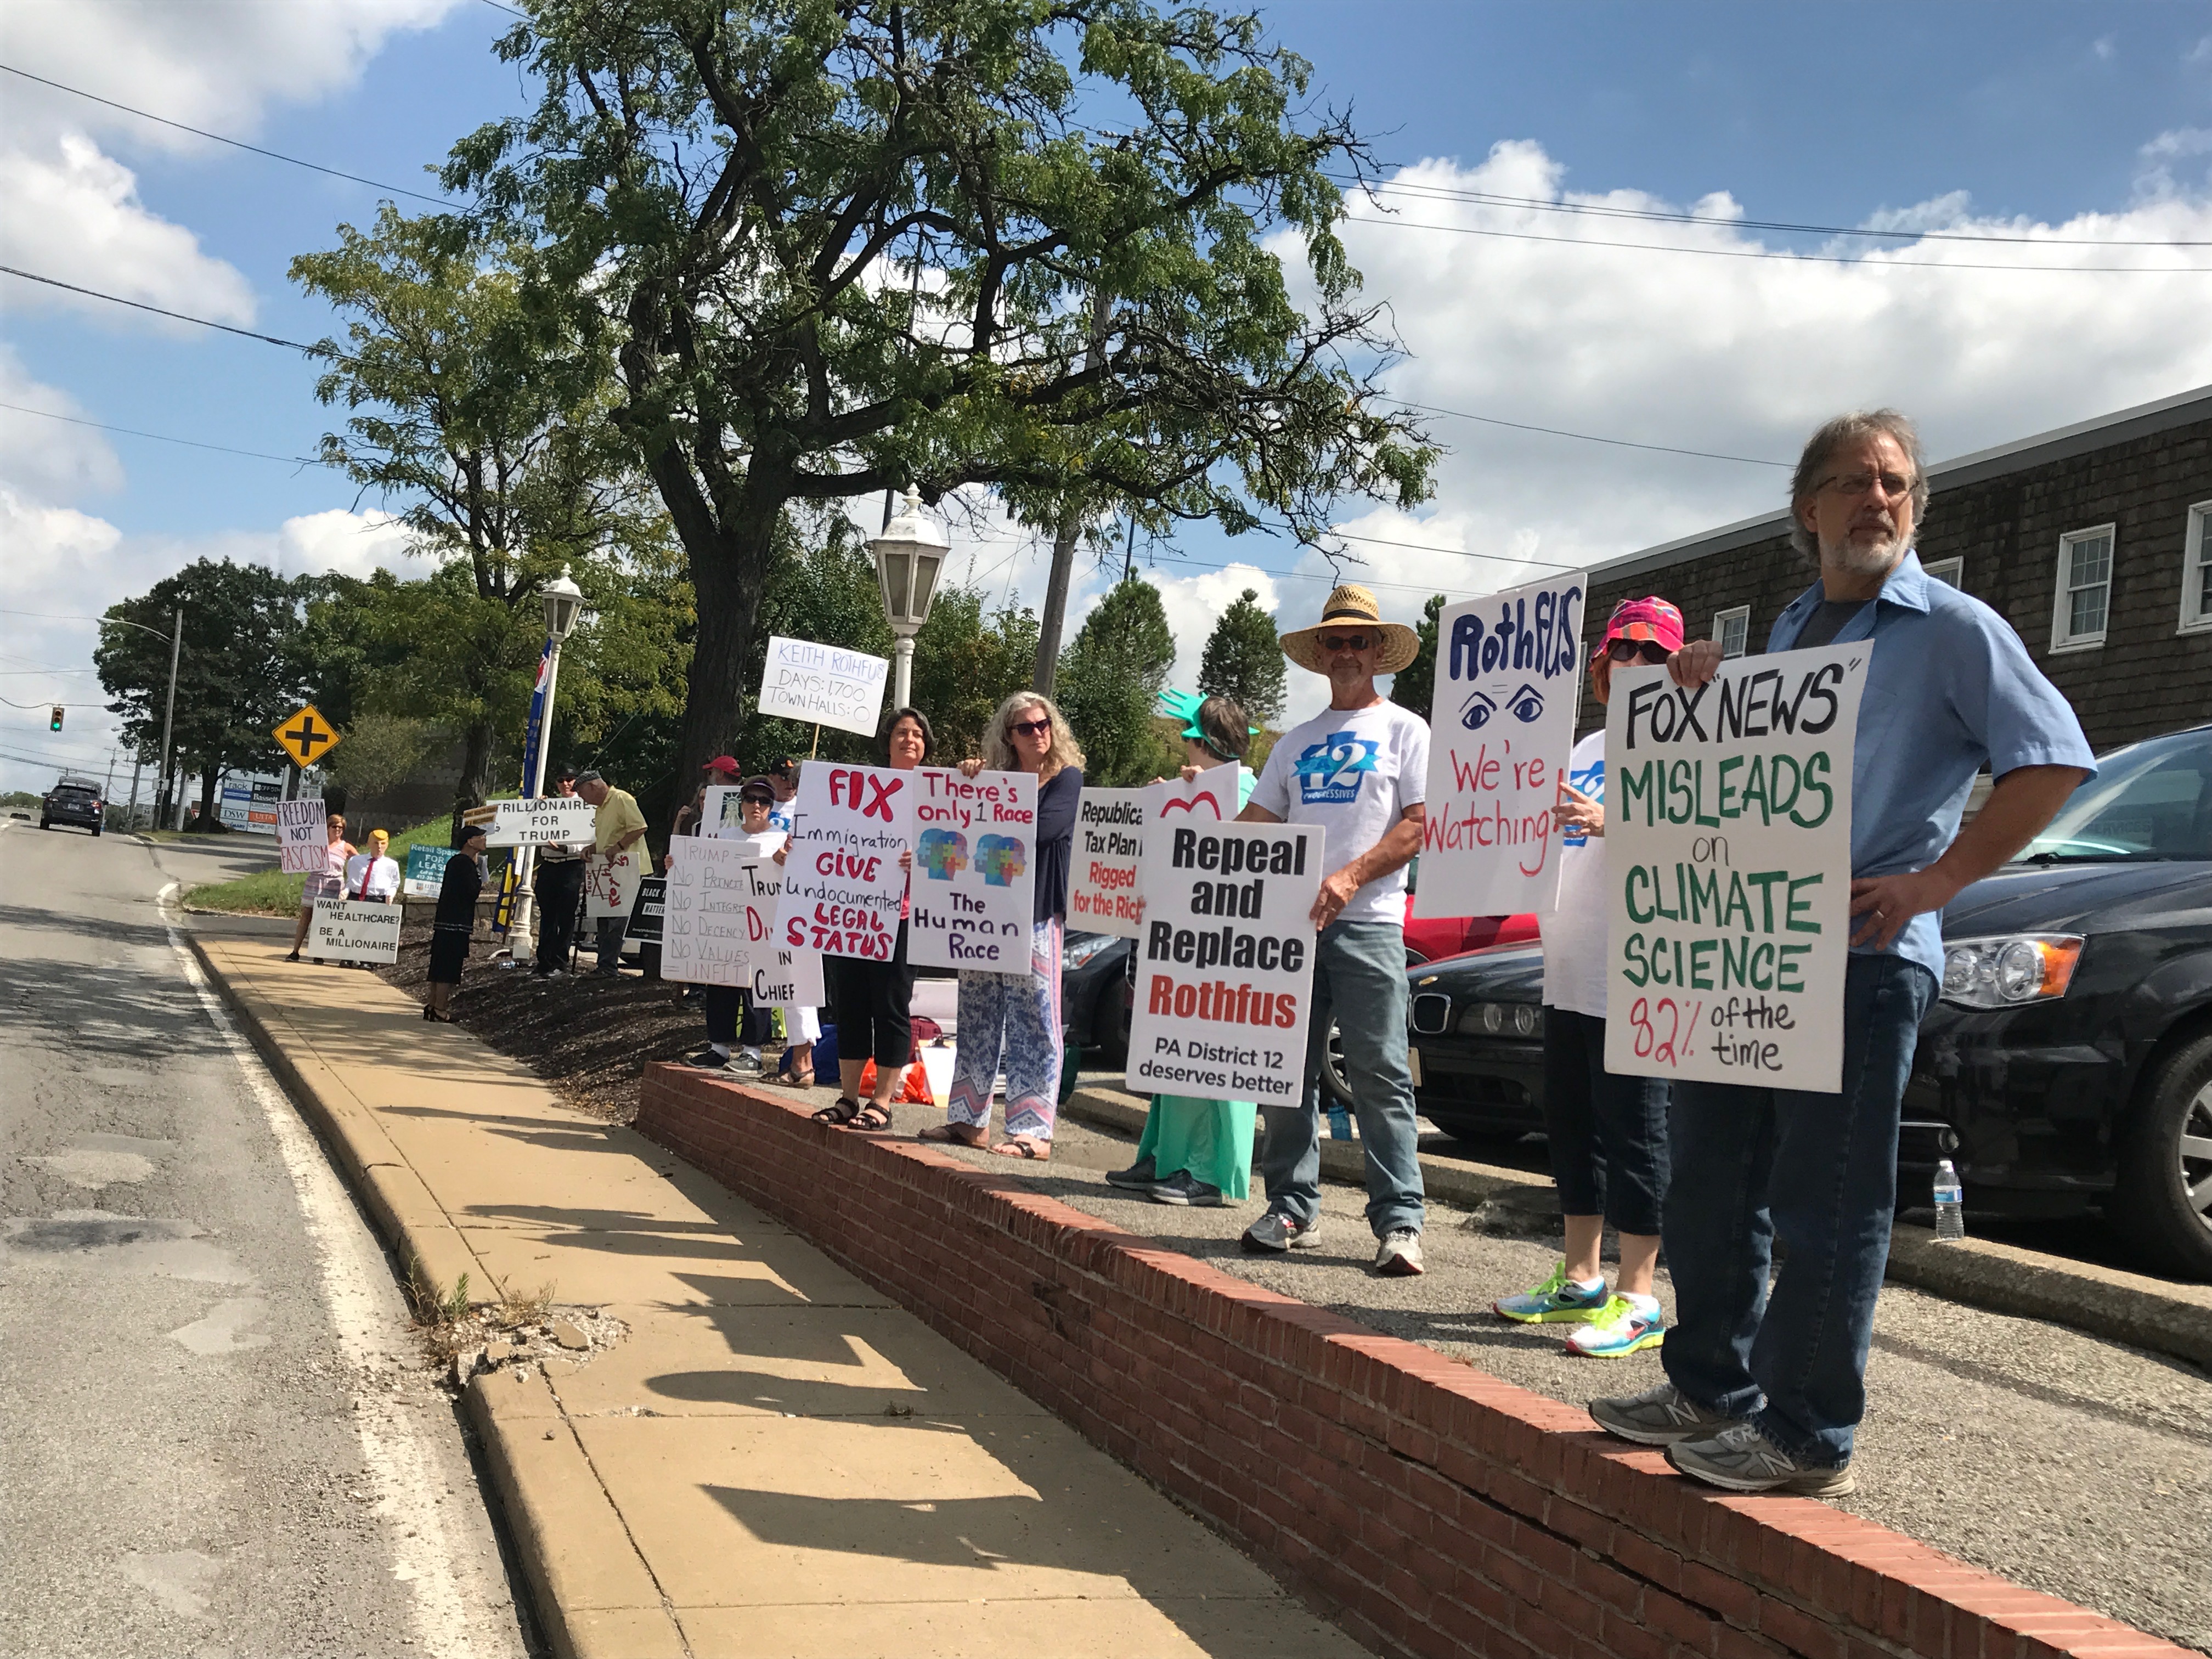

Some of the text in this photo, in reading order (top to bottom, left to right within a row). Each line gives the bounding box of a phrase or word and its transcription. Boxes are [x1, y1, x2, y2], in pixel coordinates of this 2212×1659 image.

[777, 642, 884, 680] KEITH ROTHFUS
[779, 669, 825, 692] DAYS:
[768, 686, 806, 708] TOWN
[808, 693, 850, 716] HALLS:
[1626, 679, 1709, 749] FOX
[1450, 739, 1545, 793] We're
[253, 793, 278, 803] Bassett
[828, 769, 904, 823] FIX
[922, 772, 1018, 804] There's
[1303, 789, 1356, 800] PROGRESSIVES
[1620, 751, 1833, 828] MISLEADS
[224, 810, 246, 819] DSW
[276, 801, 326, 827] FREEDOM
[532, 816, 558, 826] FOR
[917, 802, 1034, 829] only 1 Race
[1422, 768, 1563, 878] Watching!
[290, 827, 313, 840] NOT
[519, 830, 571, 841] TRUMP
[791, 814, 908, 857] Immigration
[1085, 831, 1105, 854] Tax
[1107, 832, 1137, 857] Plan
[280, 844, 330, 871] FASCISM
[411, 844, 435, 853] Retail
[425, 854, 444, 864] FOR
[677, 838, 730, 864] TRUMP
[1172, 828, 1307, 876] Repeal
[1692, 836, 1730, 866] on
[673, 866, 693, 886] No
[1089, 861, 1137, 891] Rigged
[317, 900, 347, 911] WANT
[641, 887, 661, 898] BLACK
[672, 890, 692, 911] No
[786, 876, 903, 913] Undocumented
[950, 891, 986, 914] The
[1074, 889, 1091, 913] for
[1092, 892, 1113, 917] the
[1190, 879, 1264, 919] and
[1625, 862, 1824, 934] CLIMATE
[330, 911, 399, 924] HEALTHCARE?
[672, 915, 745, 939] No DECENCY
[747, 906, 773, 941] DI
[814, 902, 884, 933] LEGAL
[915, 908, 1019, 937] Human
[319, 927, 345, 937] BE A
[326, 938, 396, 951] MILLIONAIRE
[786, 917, 894, 962] STATUS
[671, 938, 749, 963] No VALUES
[778, 951, 792, 966] IN
[949, 934, 1000, 961] Race
[1147, 920, 1305, 973] Replace
[686, 961, 743, 983] UNFIT
[1622, 932, 1813, 994] SCIENCE
[755, 969, 795, 1000] CHIEF
[1149, 974, 1297, 1029] Rothfus
[1630, 995, 1796, 1068] 82% of the
[1155, 1037, 1284, 1069] PA District 12
[1712, 1035, 1784, 1073] time
[1139, 1059, 1294, 1095] deserves better
